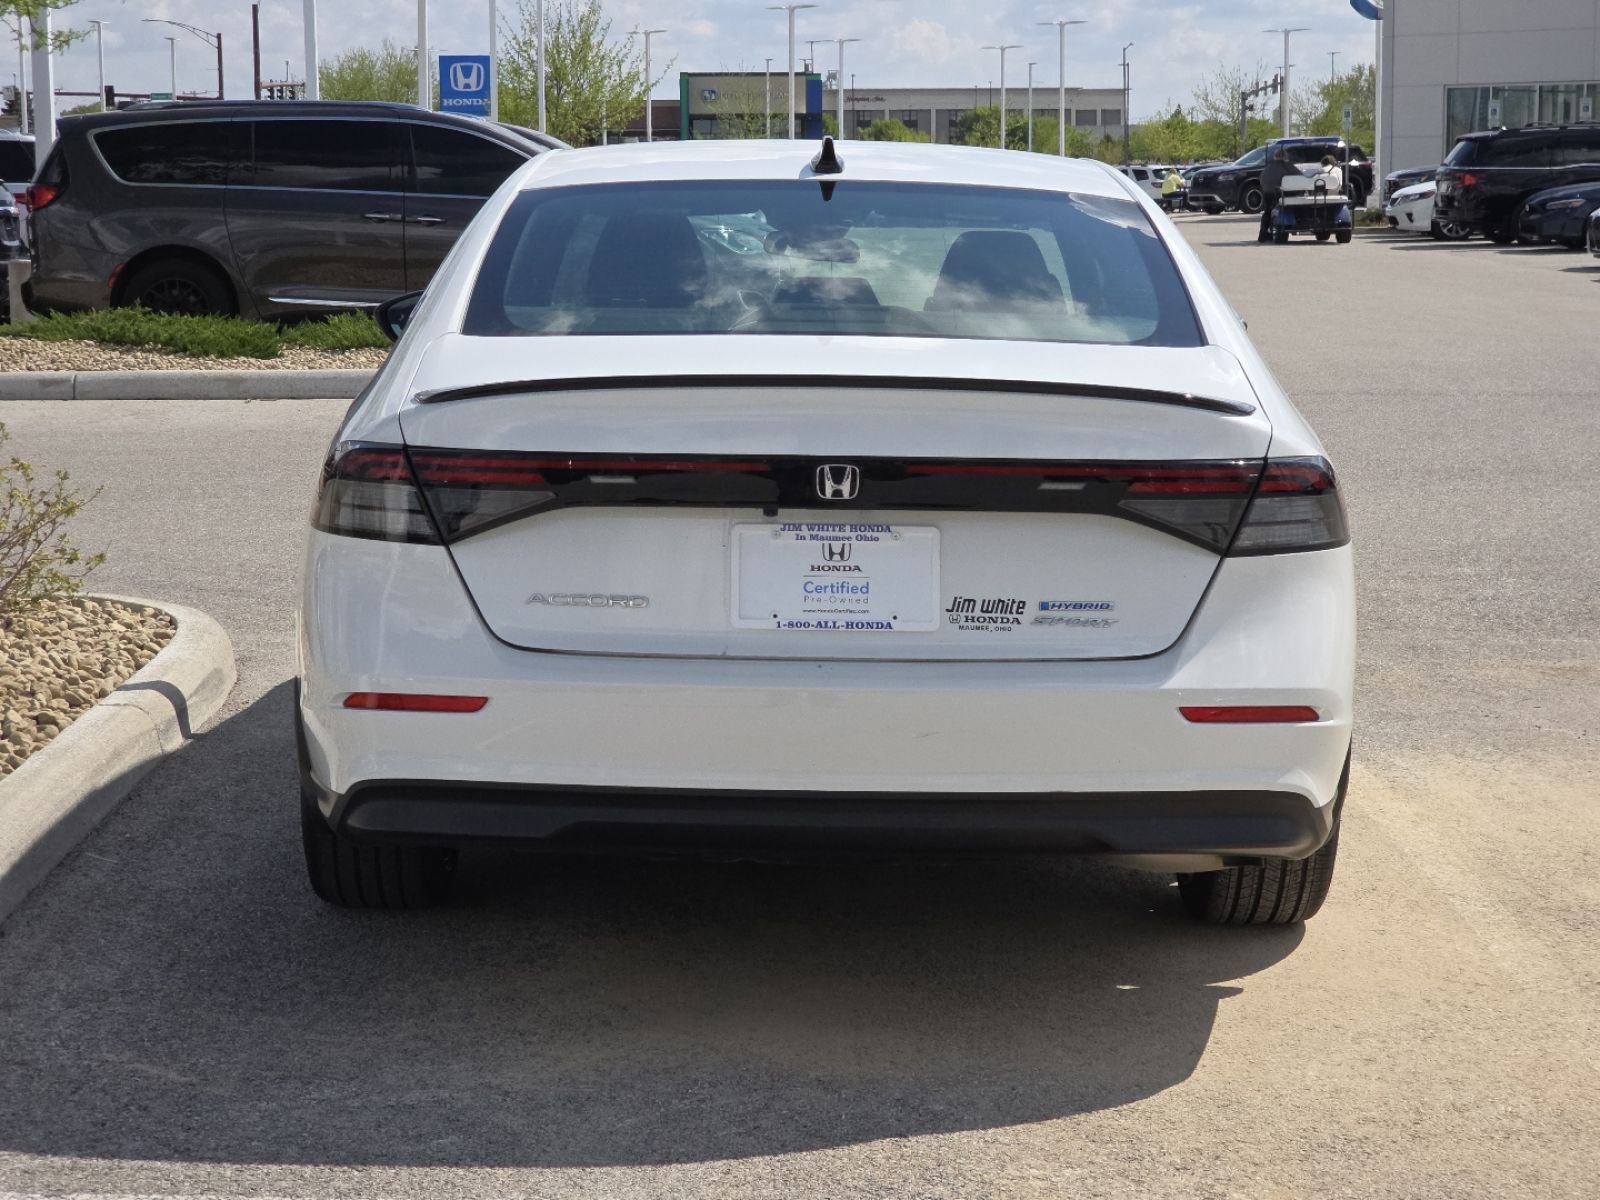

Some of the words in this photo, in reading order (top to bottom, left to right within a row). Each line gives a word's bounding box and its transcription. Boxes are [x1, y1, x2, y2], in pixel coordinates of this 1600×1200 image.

[780, 523, 802, 532] JIM
[805, 523, 846, 533] WHITE
[849, 524, 892, 533] HONDA
[795, 533, 807, 541] In
[809, 534, 852, 542] Maumee
[855, 534, 880, 542] Ohio
[810, 564, 862, 572] HONDA
[803, 581, 869, 594] Certified
[526, 592, 650, 608] ACCORD
[803, 595, 869, 604] Pre-Owned
[945, 596, 977, 613] Jim
[1050, 602, 1111, 610] HYBRID
[775, 620, 893, 630] 1-800-ALL-HONDA
[963, 615, 1022, 625] HONDA
